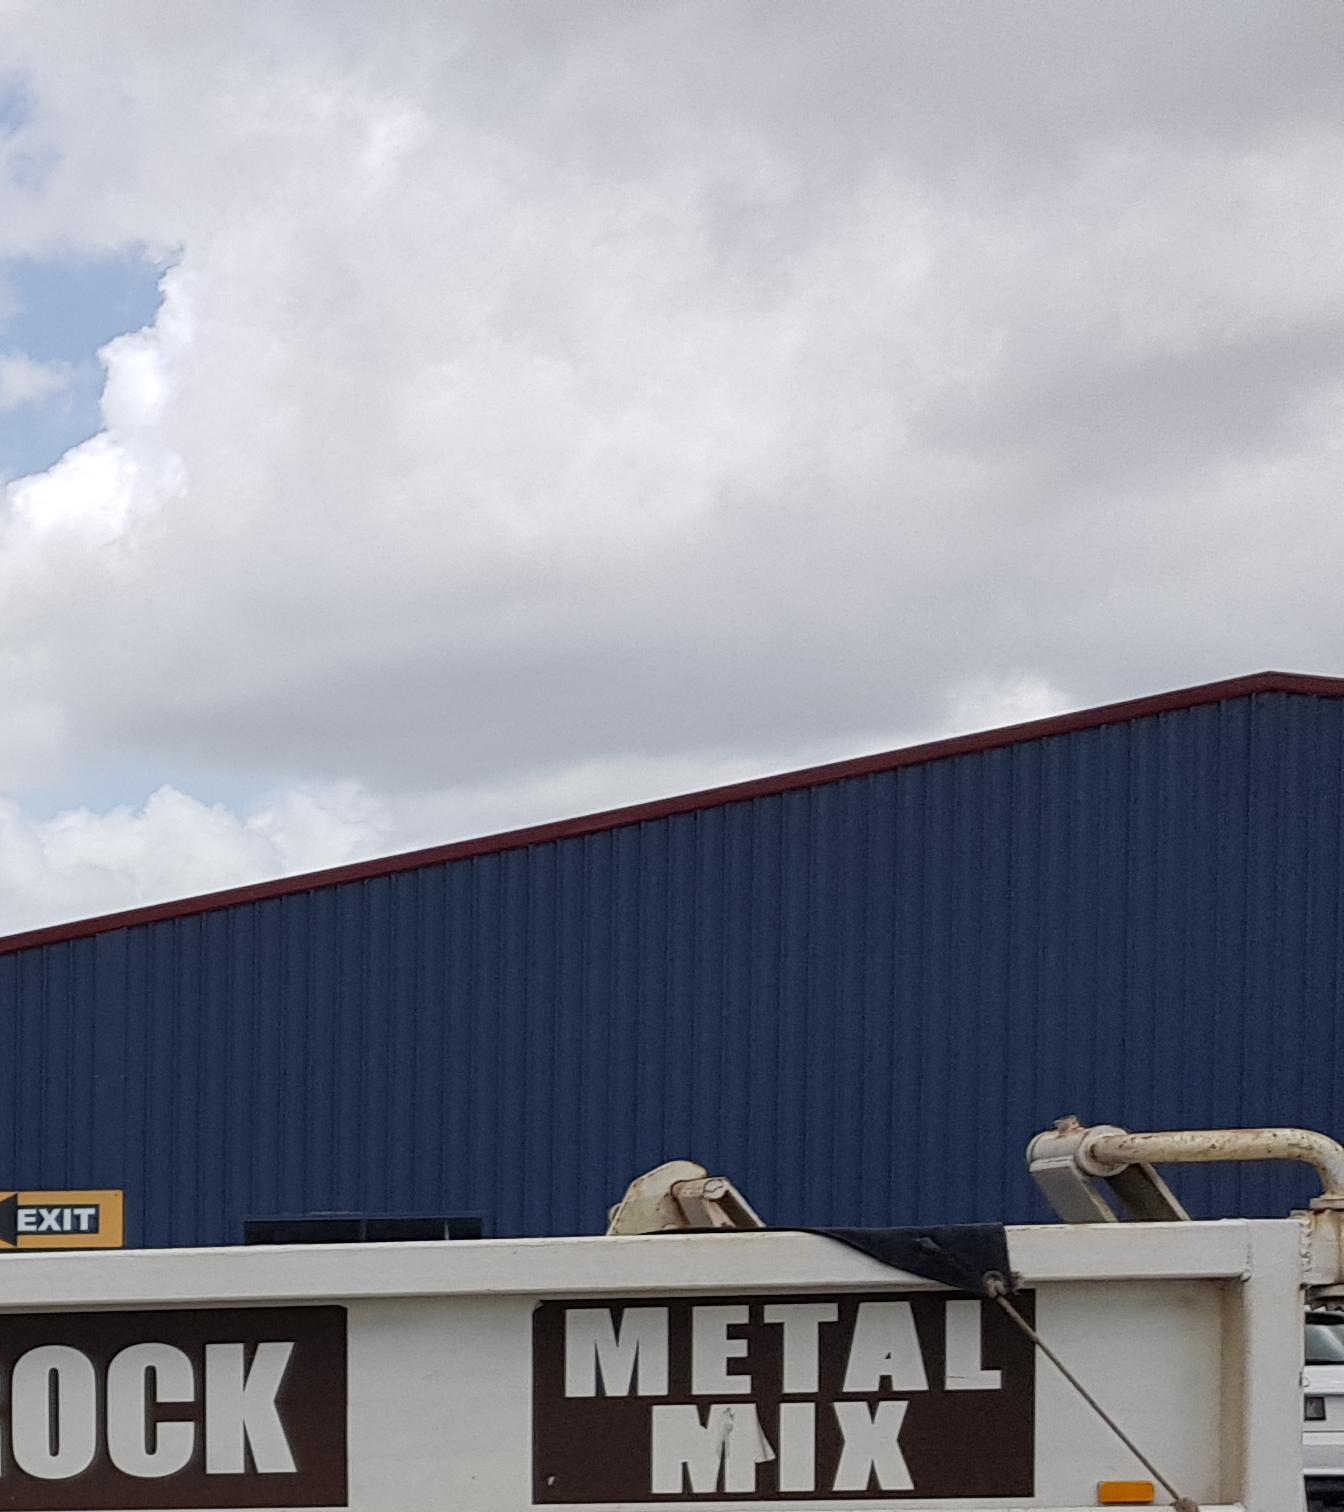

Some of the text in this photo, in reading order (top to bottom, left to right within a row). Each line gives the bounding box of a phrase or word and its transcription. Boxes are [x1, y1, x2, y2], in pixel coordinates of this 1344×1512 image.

[17, 1207, 96, 1232] EXIT
[565, 1300, 1002, 1398] METAL
[651, 1400, 915, 1494] MIX
